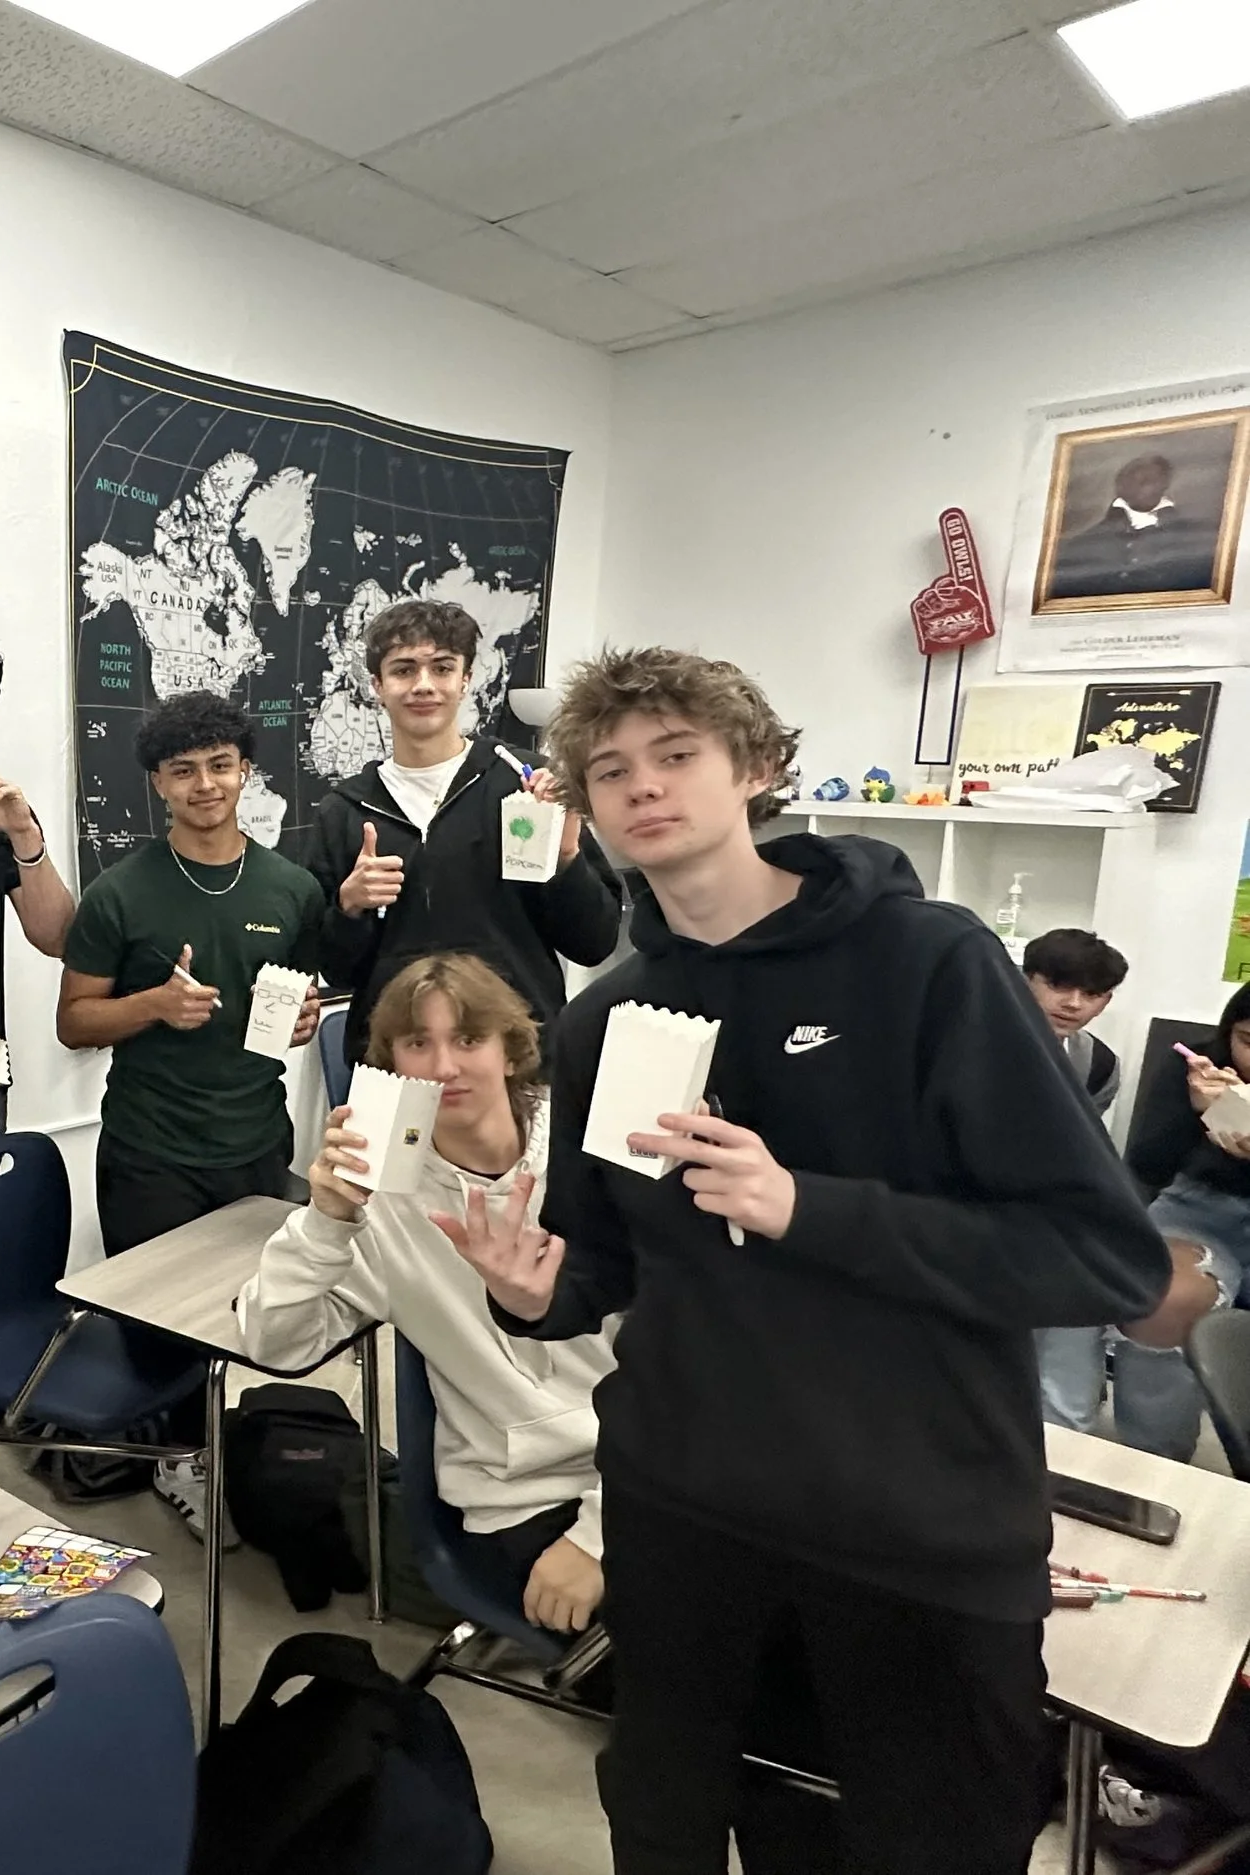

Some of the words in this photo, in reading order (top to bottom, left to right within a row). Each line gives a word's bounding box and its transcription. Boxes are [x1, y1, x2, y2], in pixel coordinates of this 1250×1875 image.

[95, 477, 129, 498] ARCTIC
[131, 486, 158, 506] OCEAN
[946, 518, 963, 536] GO
[950, 538, 975, 582] OWLS!
[97, 561, 123, 575] Alaska
[150, 591, 203, 612] CANADA
[101, 643, 131, 656] NORTH
[100, 659, 132, 673] PACIFIC
[101, 676, 130, 689] OCEAN
[258, 700, 292, 711] ATLANTIC
[263, 717, 288, 727] OCEAN
[958, 763, 990, 778] your
[994, 763, 1022, 773] own
[792, 1025, 828, 1042] NIKE
